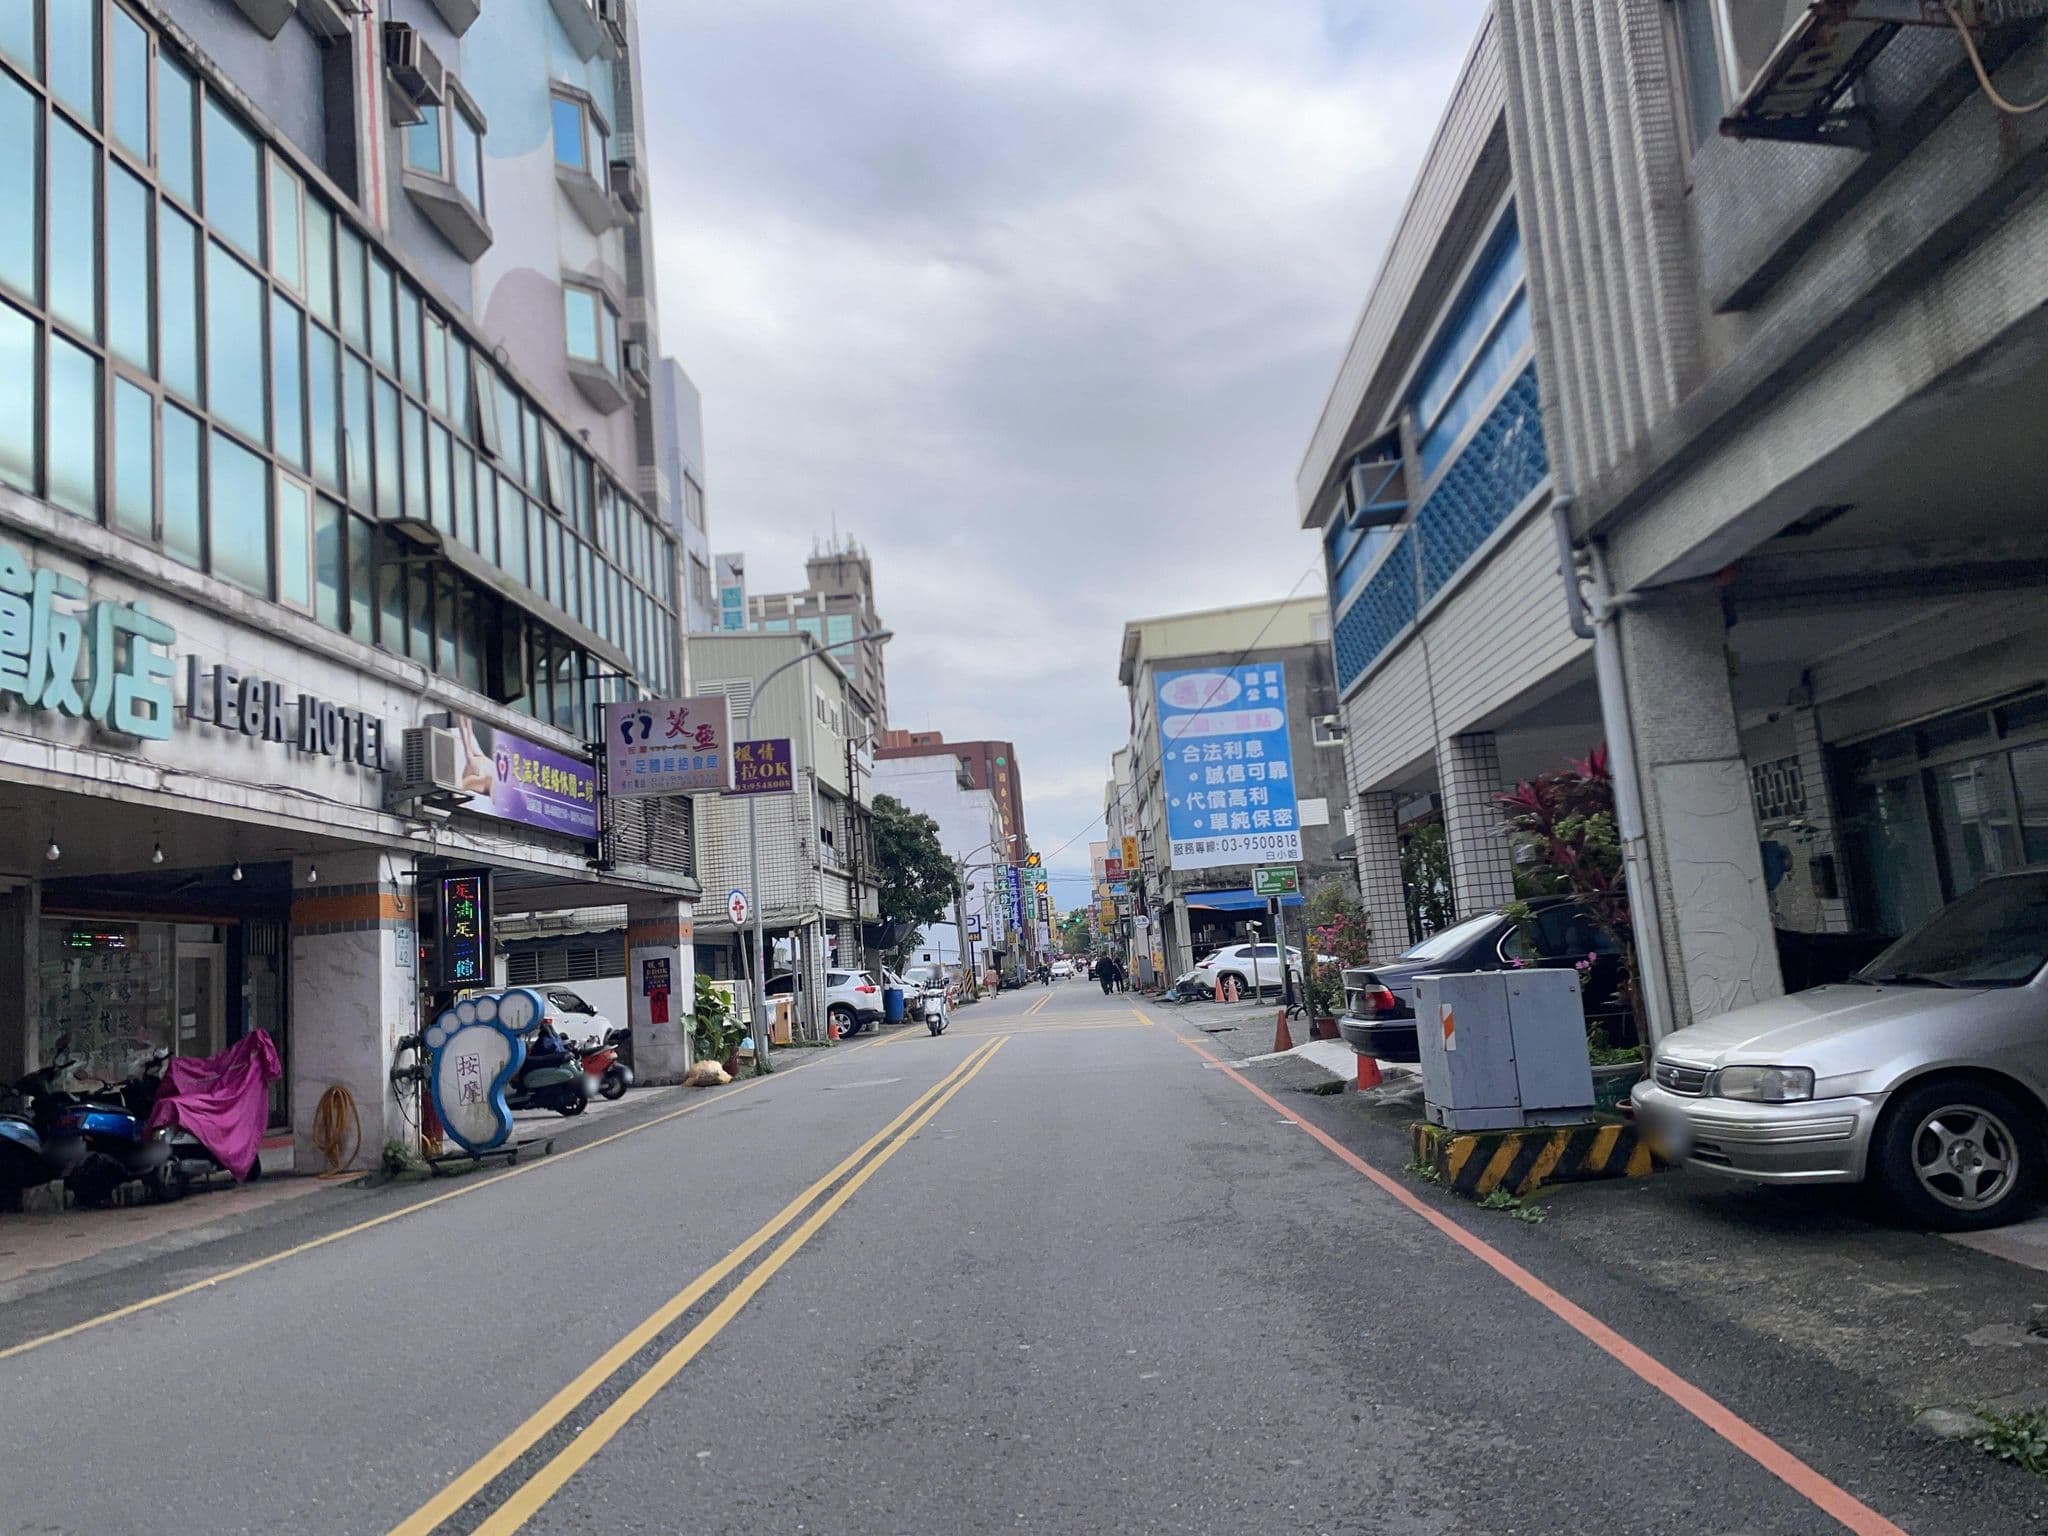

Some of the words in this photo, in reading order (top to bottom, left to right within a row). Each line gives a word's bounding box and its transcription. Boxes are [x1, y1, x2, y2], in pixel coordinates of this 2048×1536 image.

[297, 694, 392, 773] HOTEL
[1182, 740, 1265, 763] 合法利息
[1205, 761, 1289, 785] 誠信可靠
[1186, 787, 1269, 811] 代償高利
[1210, 808, 1293, 831] 單純保密
[1265, 849, 1298, 861] 白小姐
[457, 1056, 482, 1104] 按摩
